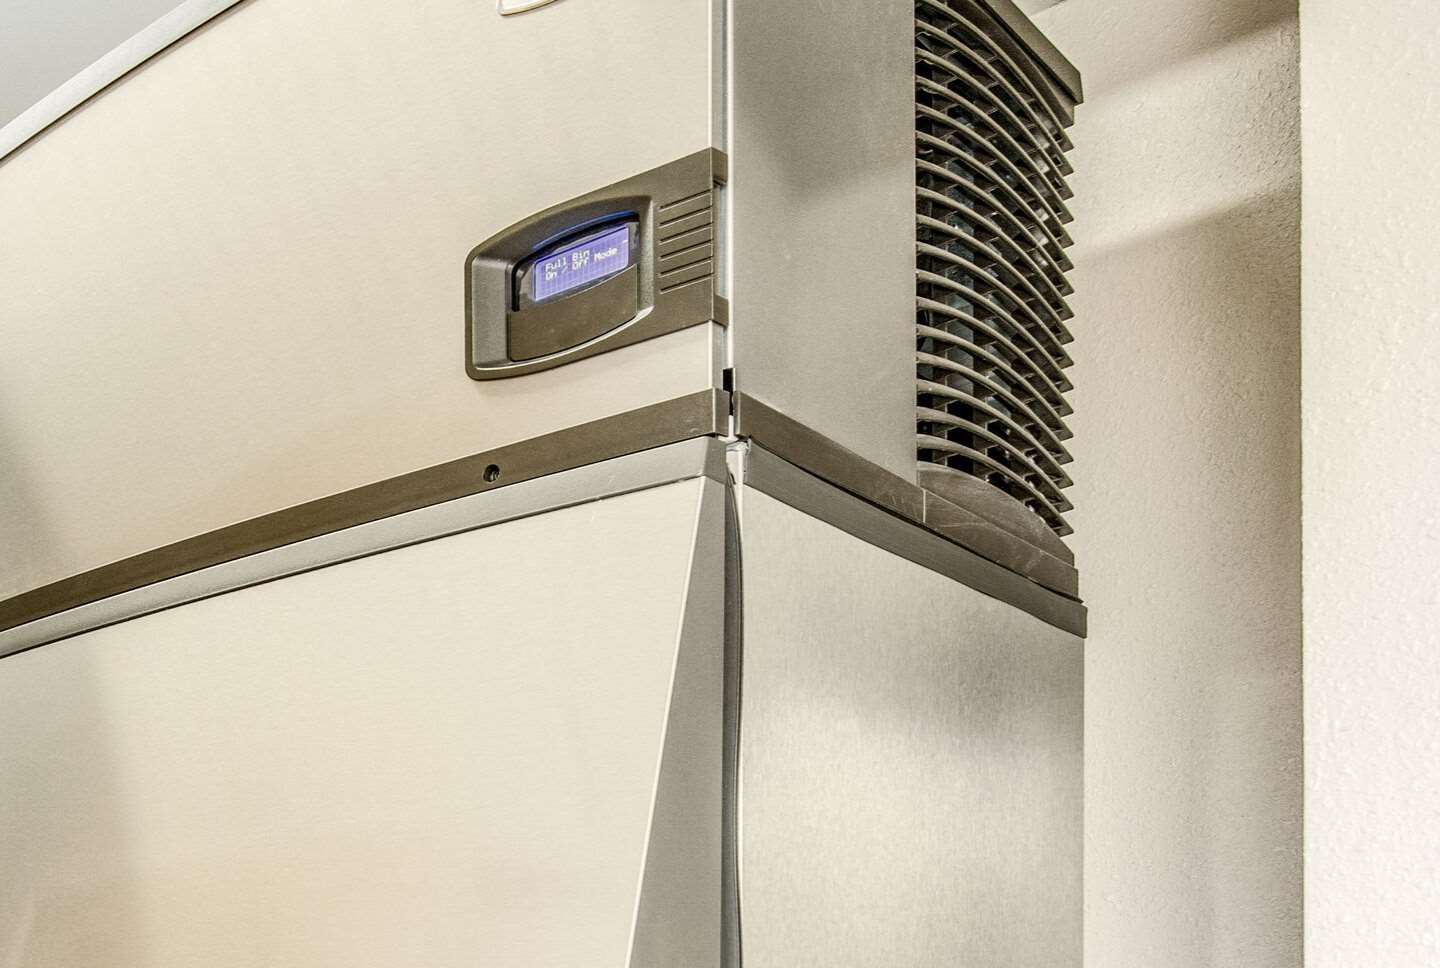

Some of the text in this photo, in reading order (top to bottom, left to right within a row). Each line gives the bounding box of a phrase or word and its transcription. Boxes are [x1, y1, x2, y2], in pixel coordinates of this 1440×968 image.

[545, 249, 590, 272] Full Bin
[545, 270, 557, 281] On
[572, 257, 589, 271] Off
[594, 247, 618, 262] Mode
